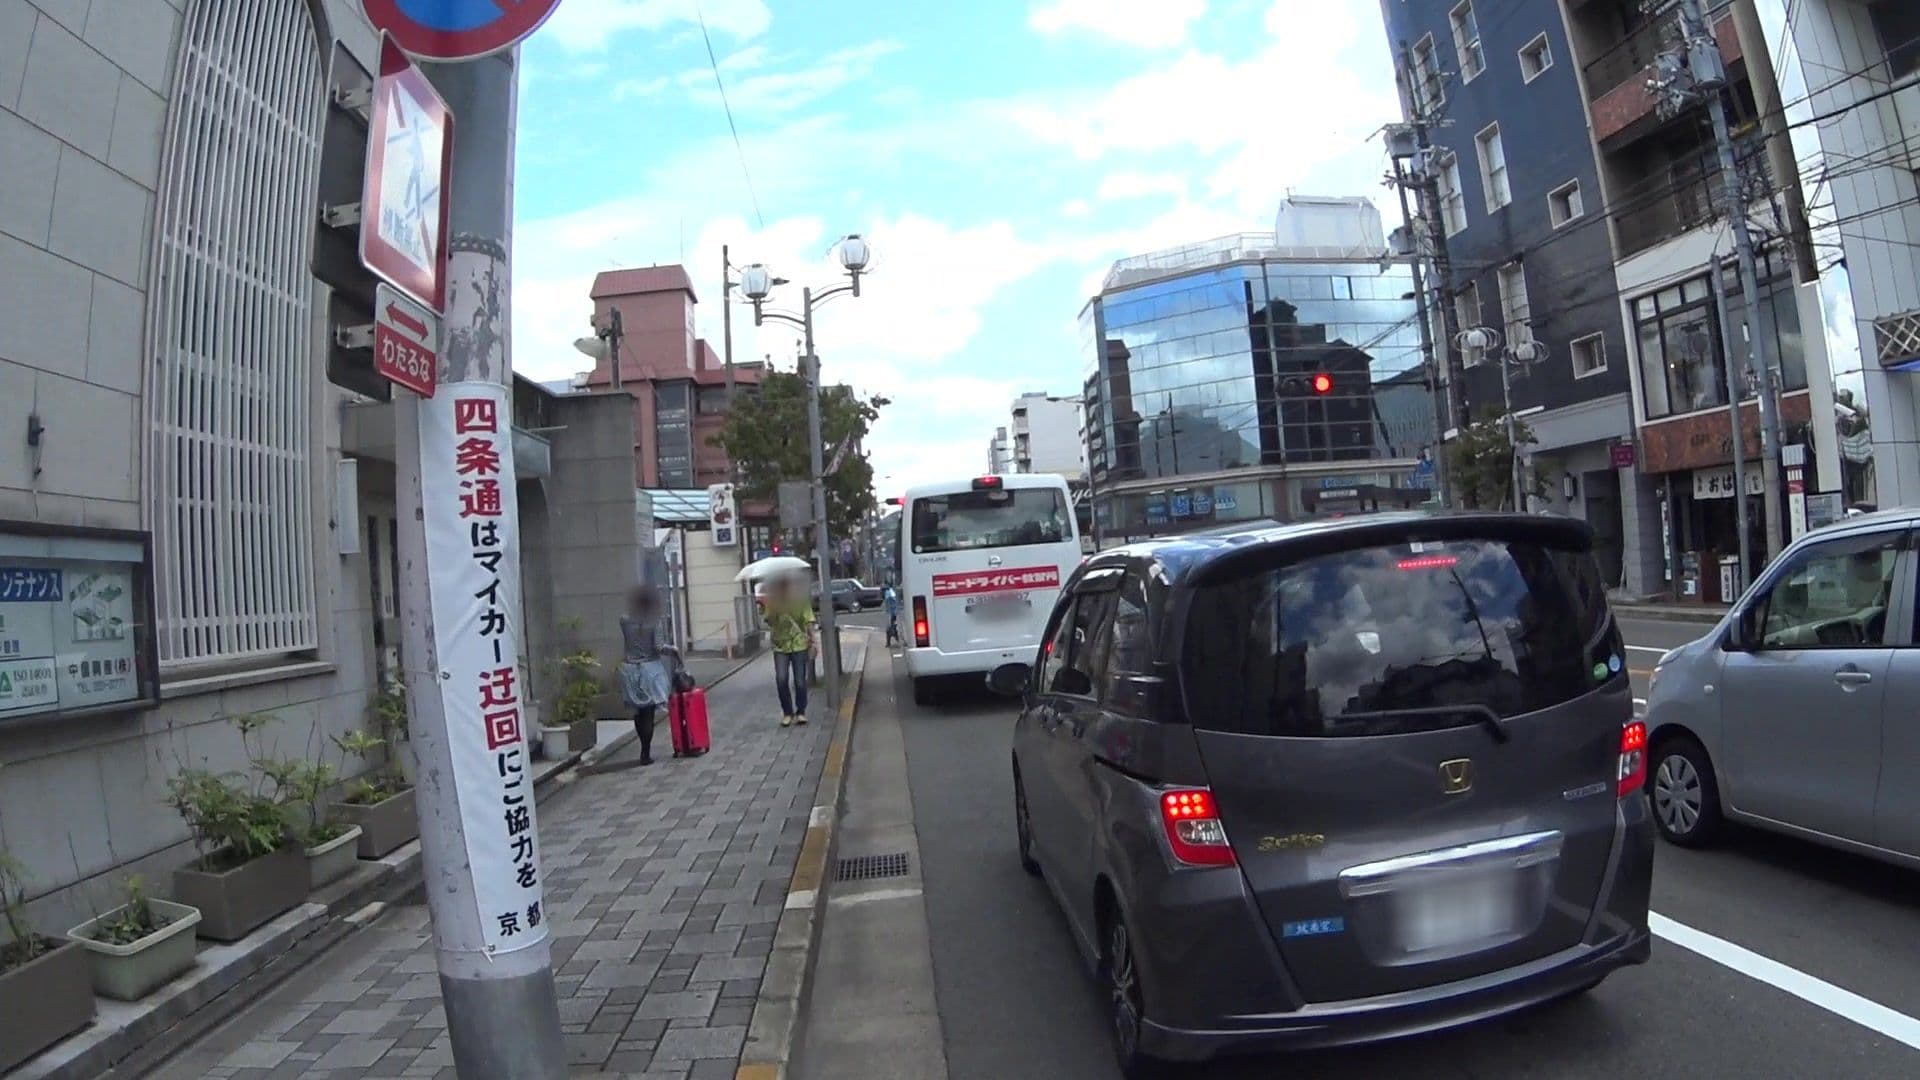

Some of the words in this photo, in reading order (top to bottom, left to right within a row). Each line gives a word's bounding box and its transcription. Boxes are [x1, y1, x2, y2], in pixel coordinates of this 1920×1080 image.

[382, 334, 430, 383] わたるな
[497, 901, 541, 936] 京都
